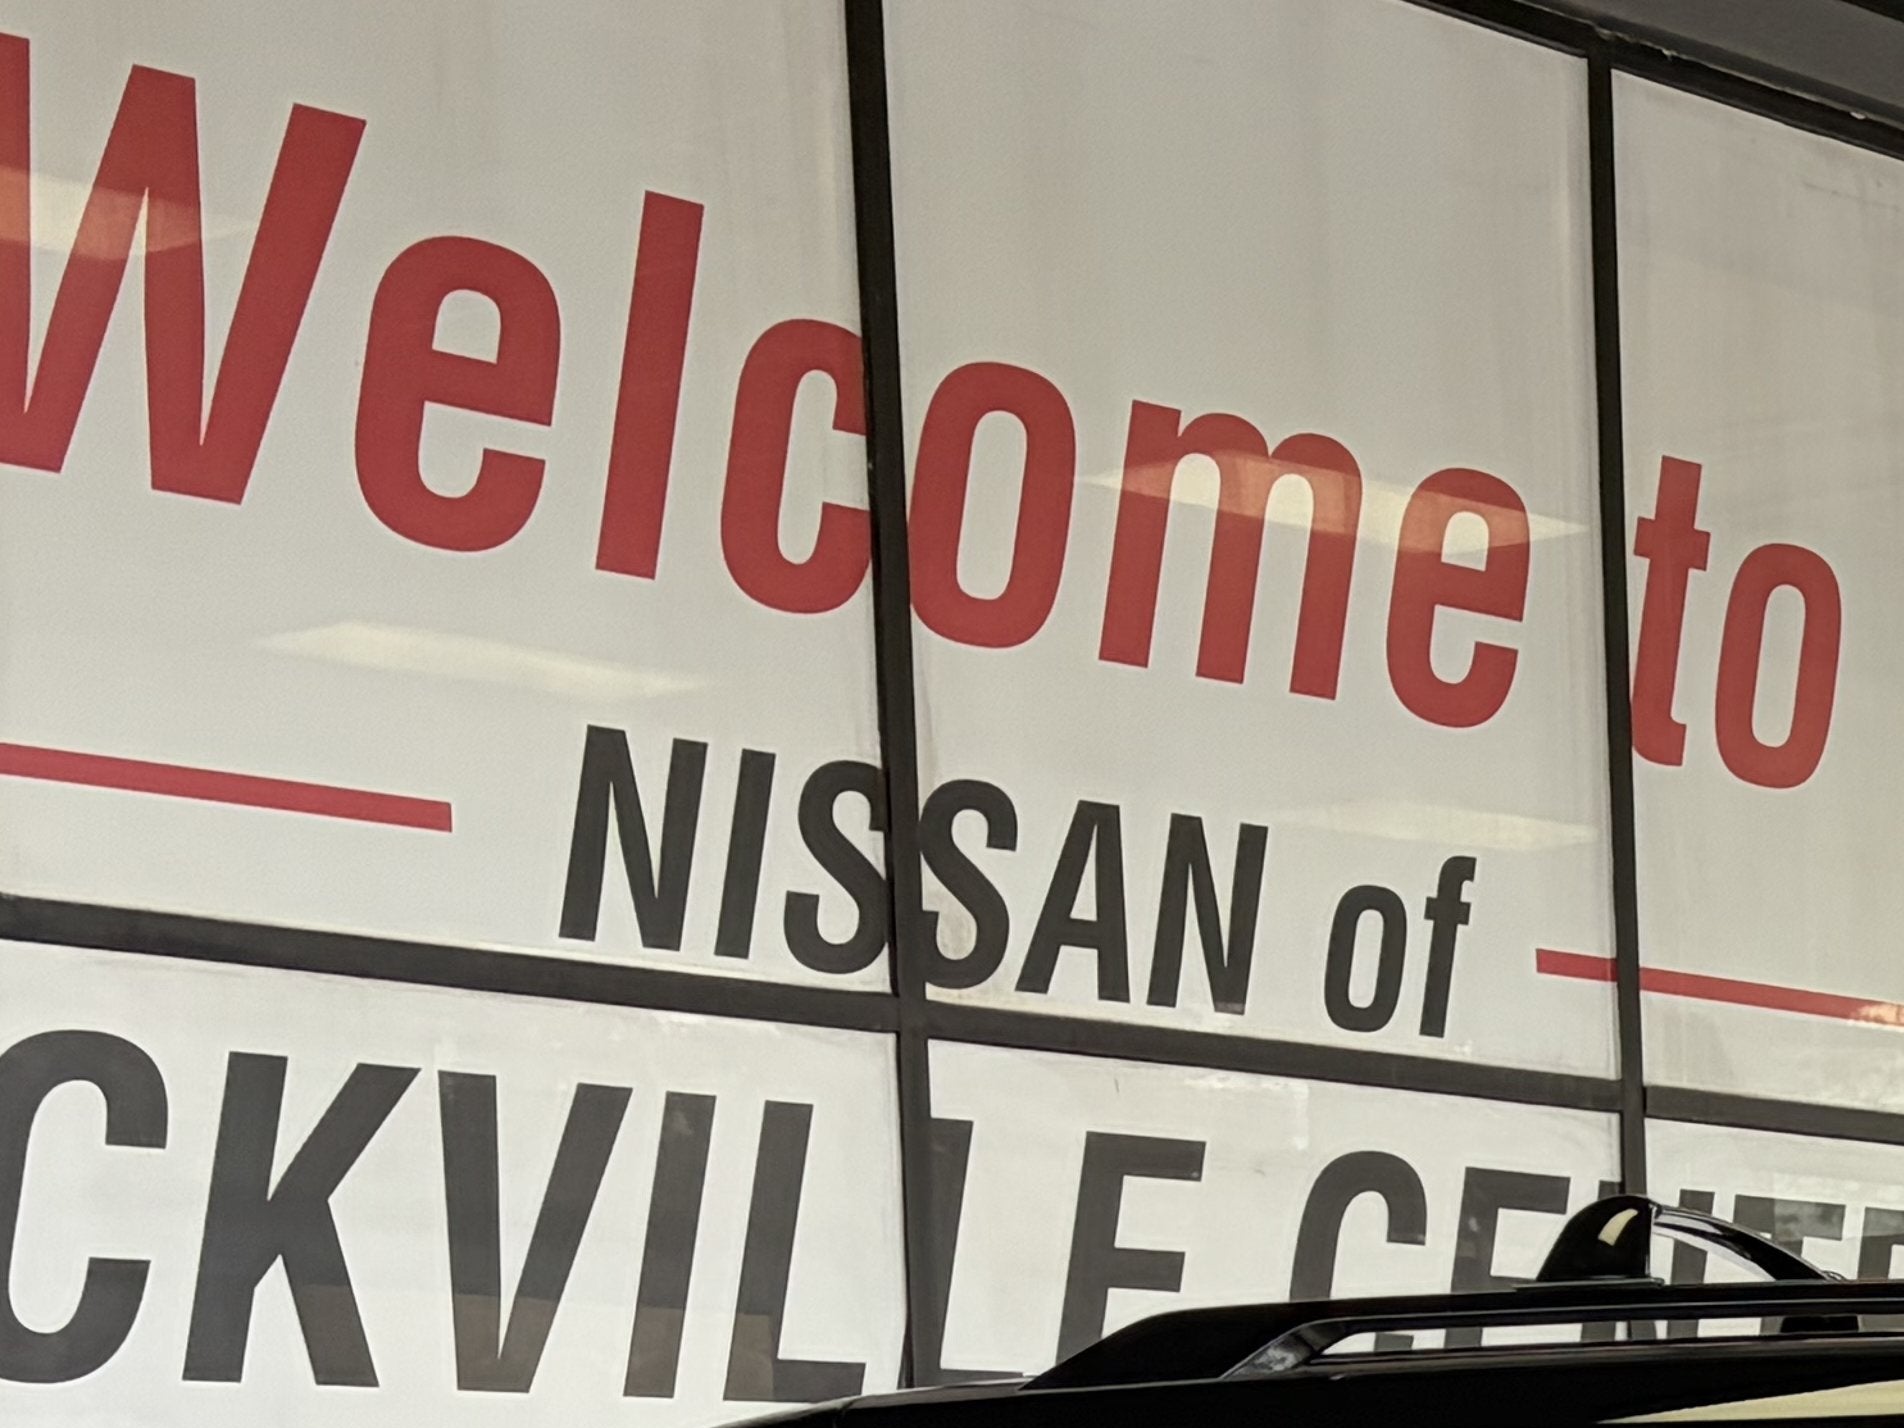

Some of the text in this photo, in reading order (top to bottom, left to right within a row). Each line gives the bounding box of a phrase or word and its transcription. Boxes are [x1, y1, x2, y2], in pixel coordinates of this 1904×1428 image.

[0, 33, 1844, 791] Welcome to
[559, 725, 1476, 1038] NISSAN of
